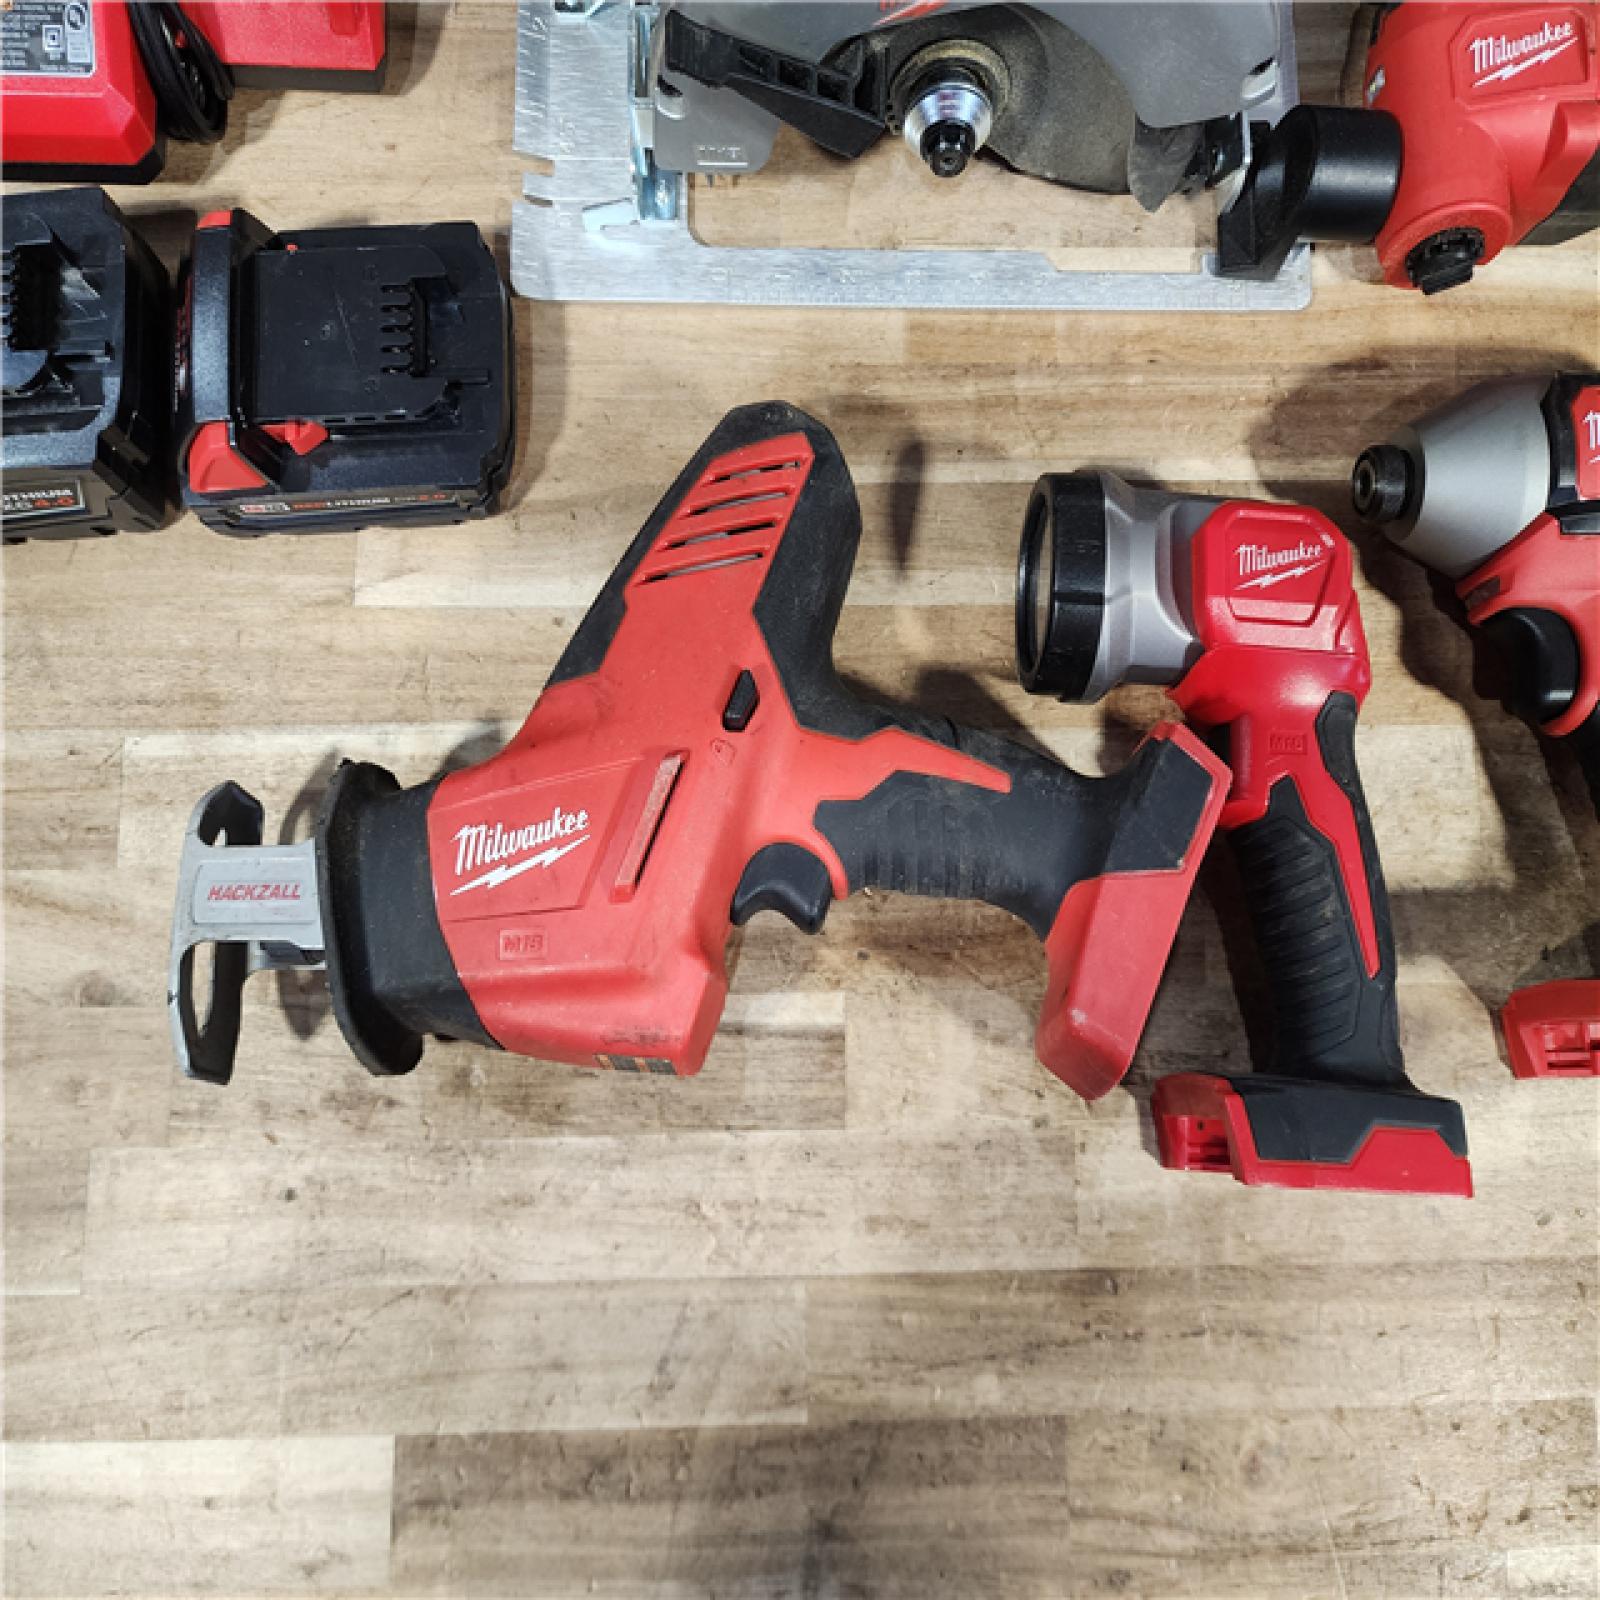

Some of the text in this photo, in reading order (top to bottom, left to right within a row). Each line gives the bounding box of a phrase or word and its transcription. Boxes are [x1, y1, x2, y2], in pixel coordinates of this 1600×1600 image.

[1469, 21, 1573, 74] Milwaukee
[1233, 540, 1321, 576] Milwaukee
[450, 806, 589, 876] Milwaukee
[207, 884, 301, 901] HACKZALL
